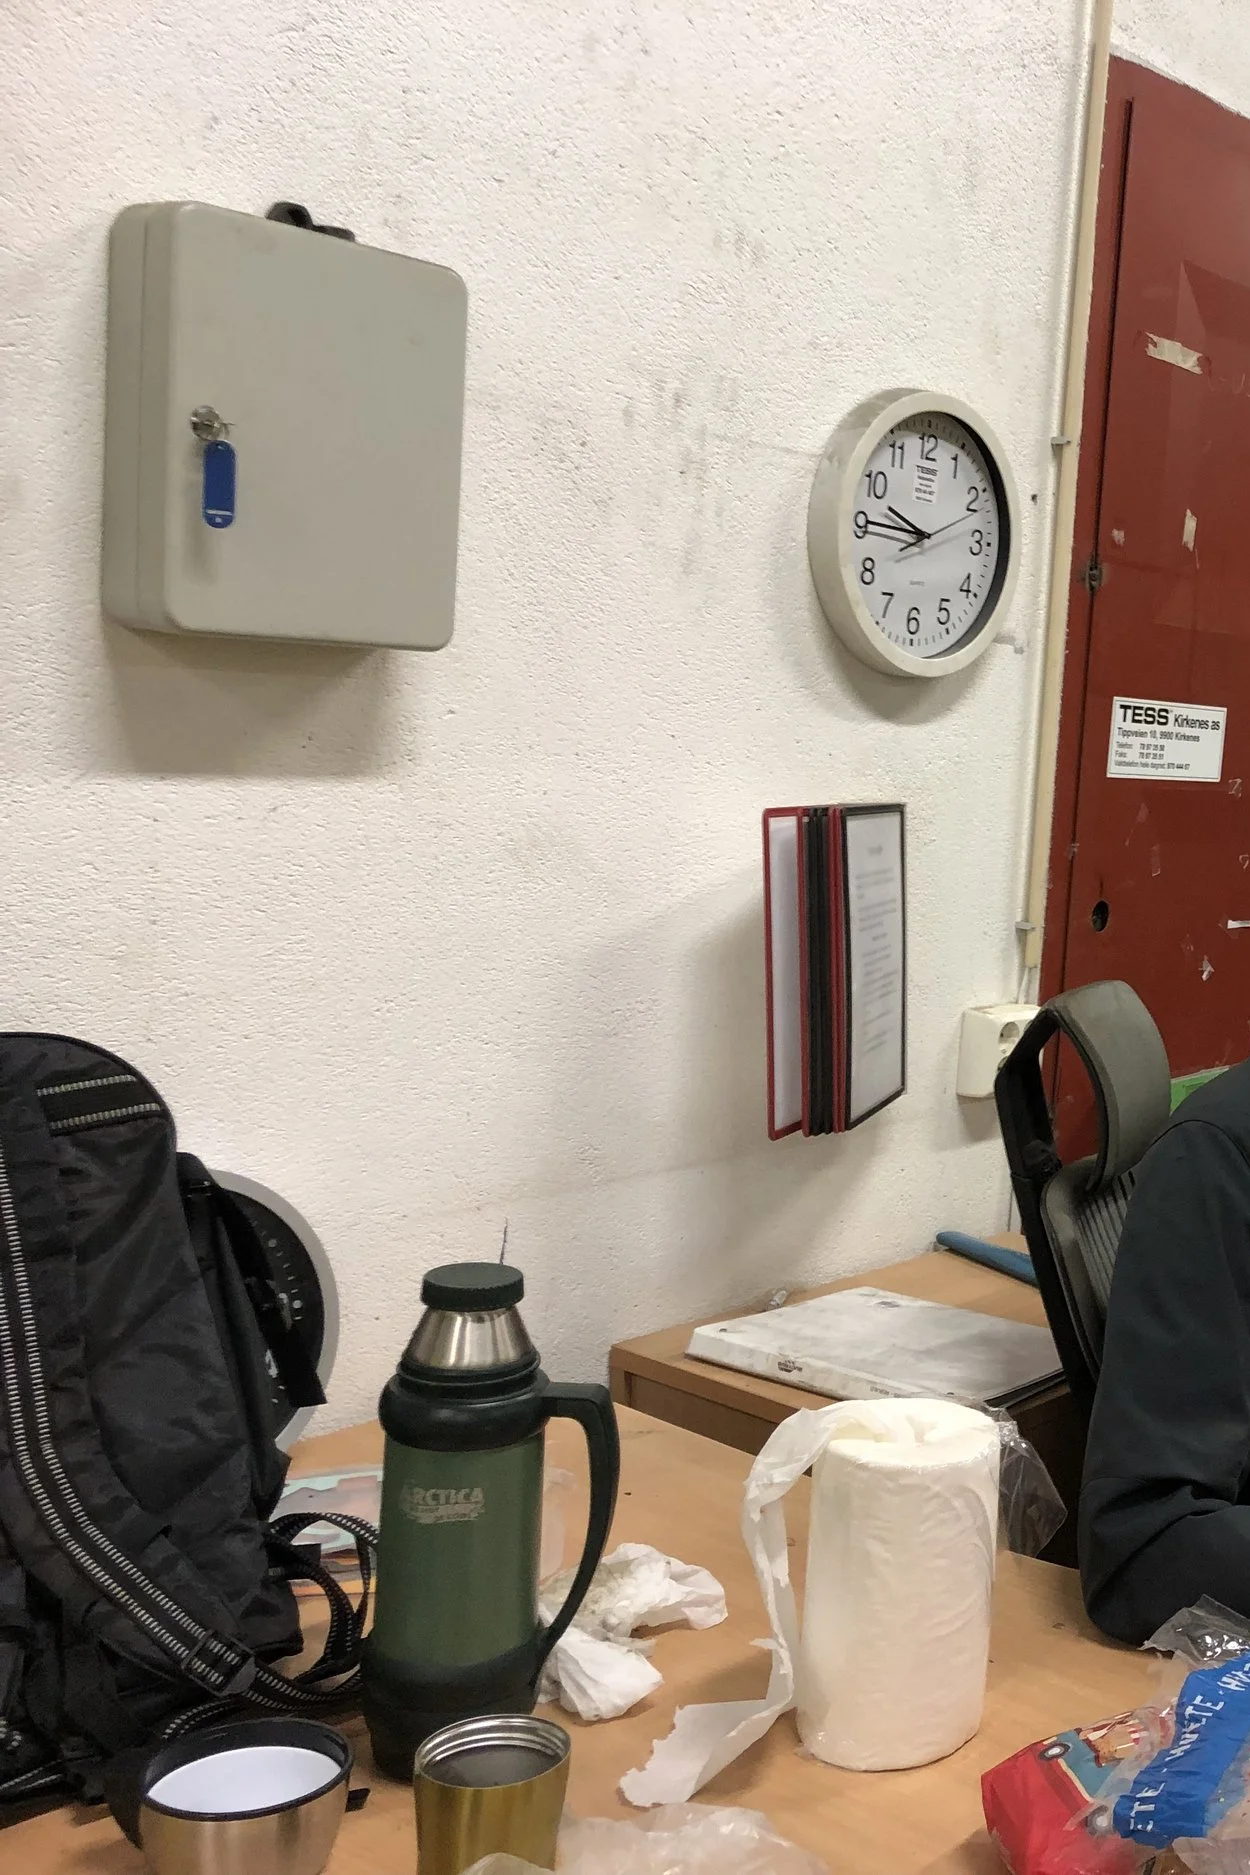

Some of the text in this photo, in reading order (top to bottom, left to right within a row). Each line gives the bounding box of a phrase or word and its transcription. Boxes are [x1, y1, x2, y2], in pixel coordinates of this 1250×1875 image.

[889, 441, 905, 469] 11
[919, 433, 938, 463] 12
[916, 465, 939, 477] TESS
[951, 453, 959, 479] 1
[865, 469, 888, 500] 10
[966, 486, 979, 512] 2
[854, 510, 868, 539] 9
[969, 530, 983, 556] 3
[860, 557, 875, 586] 8
[959, 573, 972, 599] 4
[881, 591, 894, 619] 7
[937, 598, 951, 625] 5
[906, 606, 920, 635] 6
[1119, 704, 1220, 731] TESS Kirkenes as
[1117, 727, 1148, 740] Tippveien
[1174, 731, 1200, 743] Kirkenes
